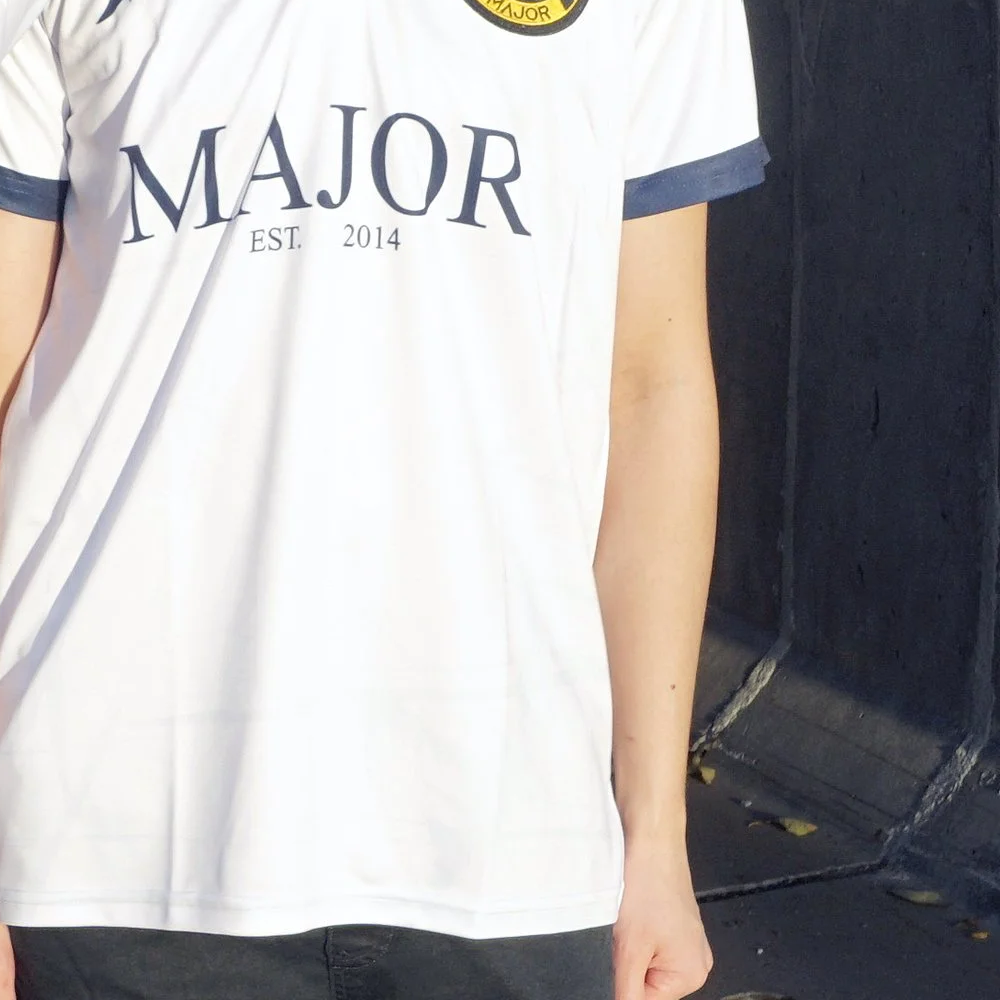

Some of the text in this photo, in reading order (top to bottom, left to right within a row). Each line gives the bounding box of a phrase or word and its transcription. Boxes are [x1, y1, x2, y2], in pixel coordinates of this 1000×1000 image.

[119, 104, 532, 244] MAJOR
[250, 224, 401, 253] EST. 2014
